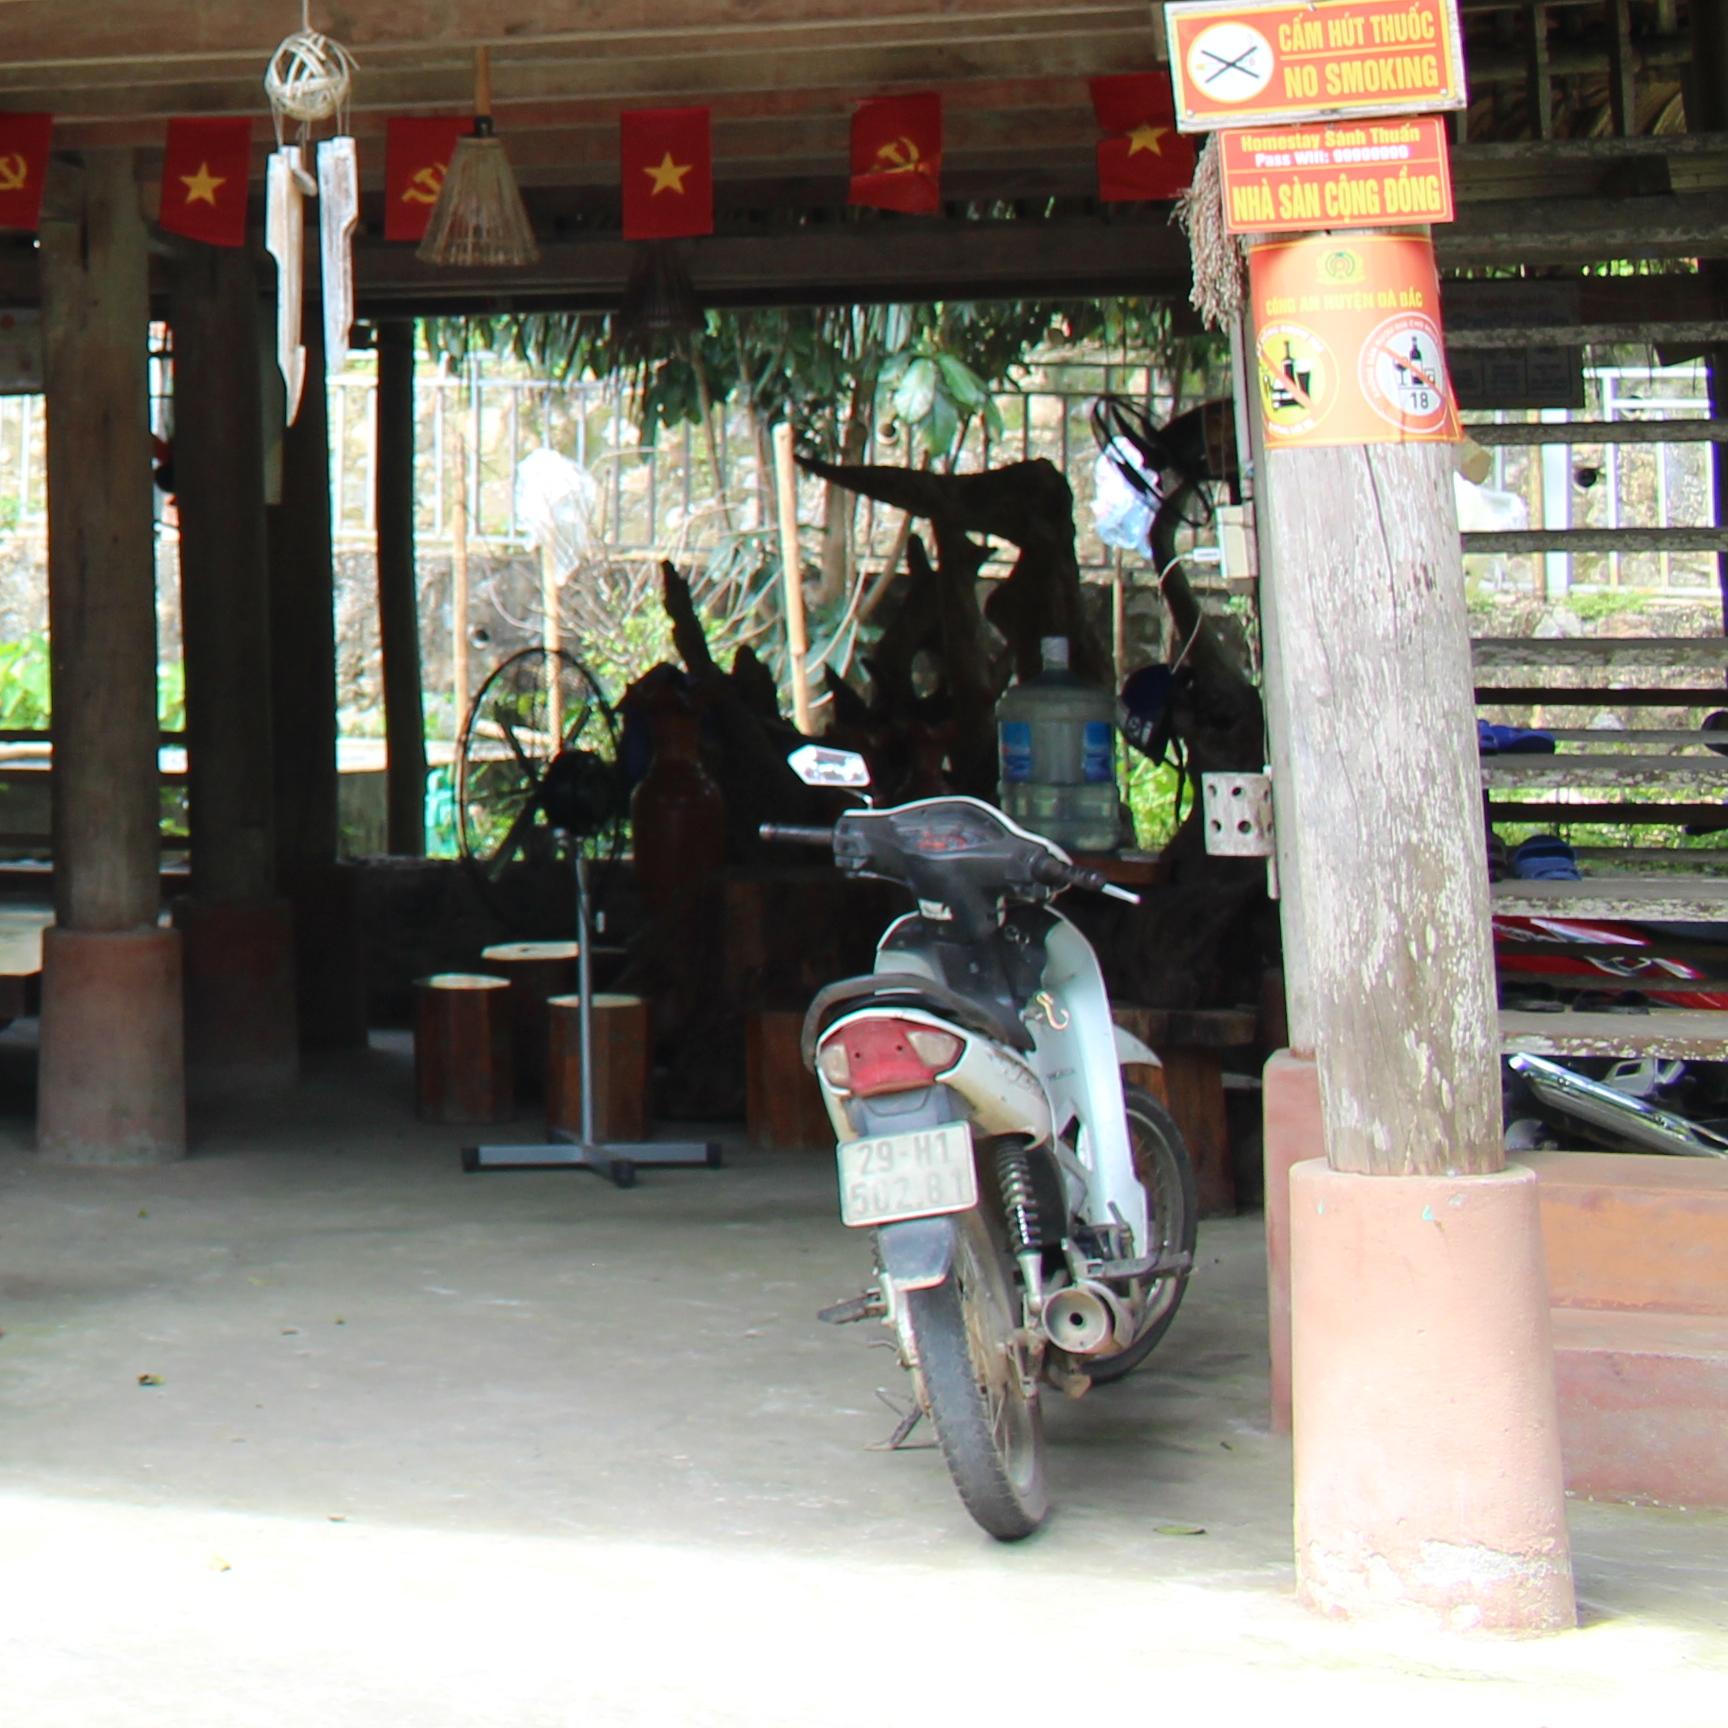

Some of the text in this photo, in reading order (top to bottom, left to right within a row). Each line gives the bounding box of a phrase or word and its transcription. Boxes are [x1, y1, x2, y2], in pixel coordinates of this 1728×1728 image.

[1278, 2, 1435, 52] CẤM HÚT THUỐC
[1284, 54, 1439, 99] NO SMOKING
[1241, 132, 1320, 152] Homestay
[1255, 152, 1291, 167] Pass
[1294, 149, 1330, 165] Wifi:
[1233, 165, 1440, 223] NHÀ SÀN CỘNG ĐỒNG
[1265, 295, 1296, 316] CÔNG
[1299, 295, 1321, 313] AN
[1410, 392, 1429, 410] 18
[857, 1131, 949, 1175] 29-H1
